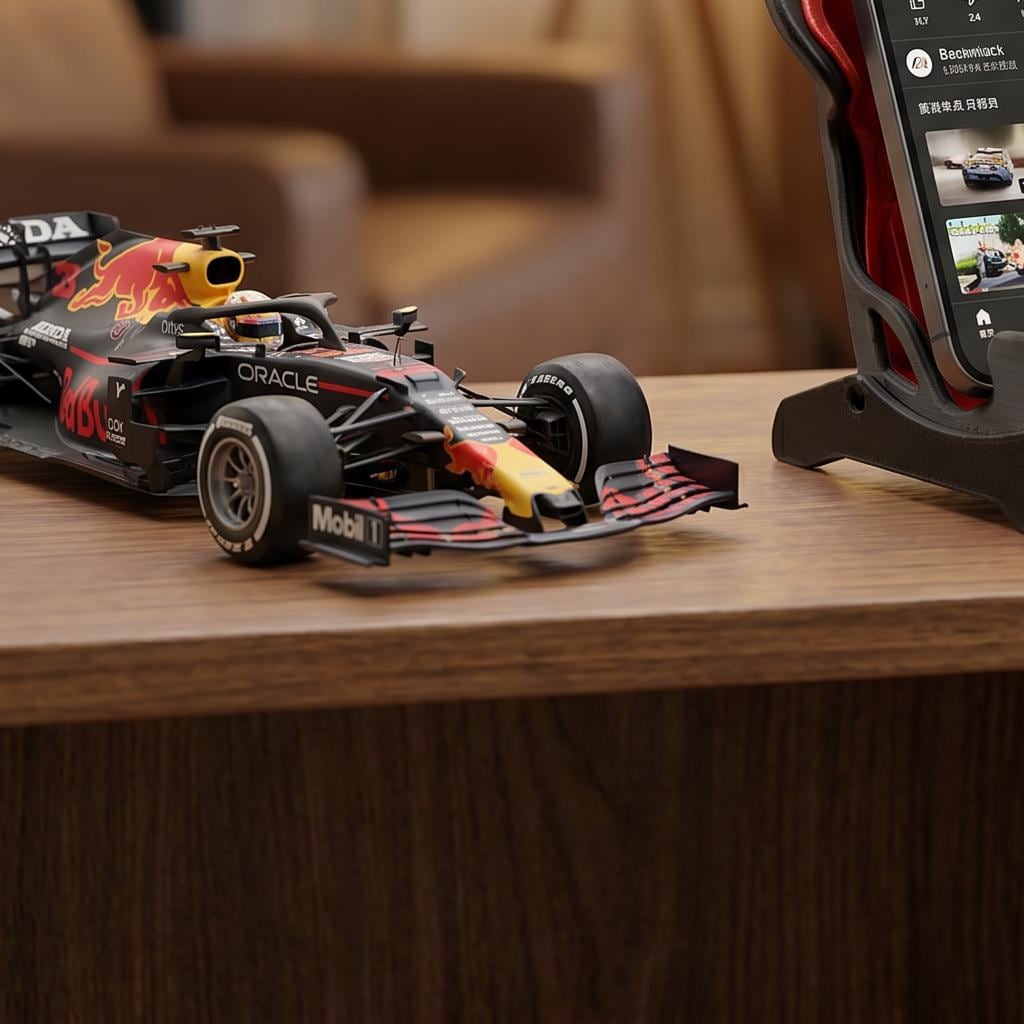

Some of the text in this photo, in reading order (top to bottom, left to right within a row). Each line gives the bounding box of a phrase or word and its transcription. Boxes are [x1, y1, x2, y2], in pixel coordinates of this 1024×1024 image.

[968, 12, 981, 23] 24
[237, 362, 319, 395] ORACLE
[312, 503, 364, 542] Mobil
